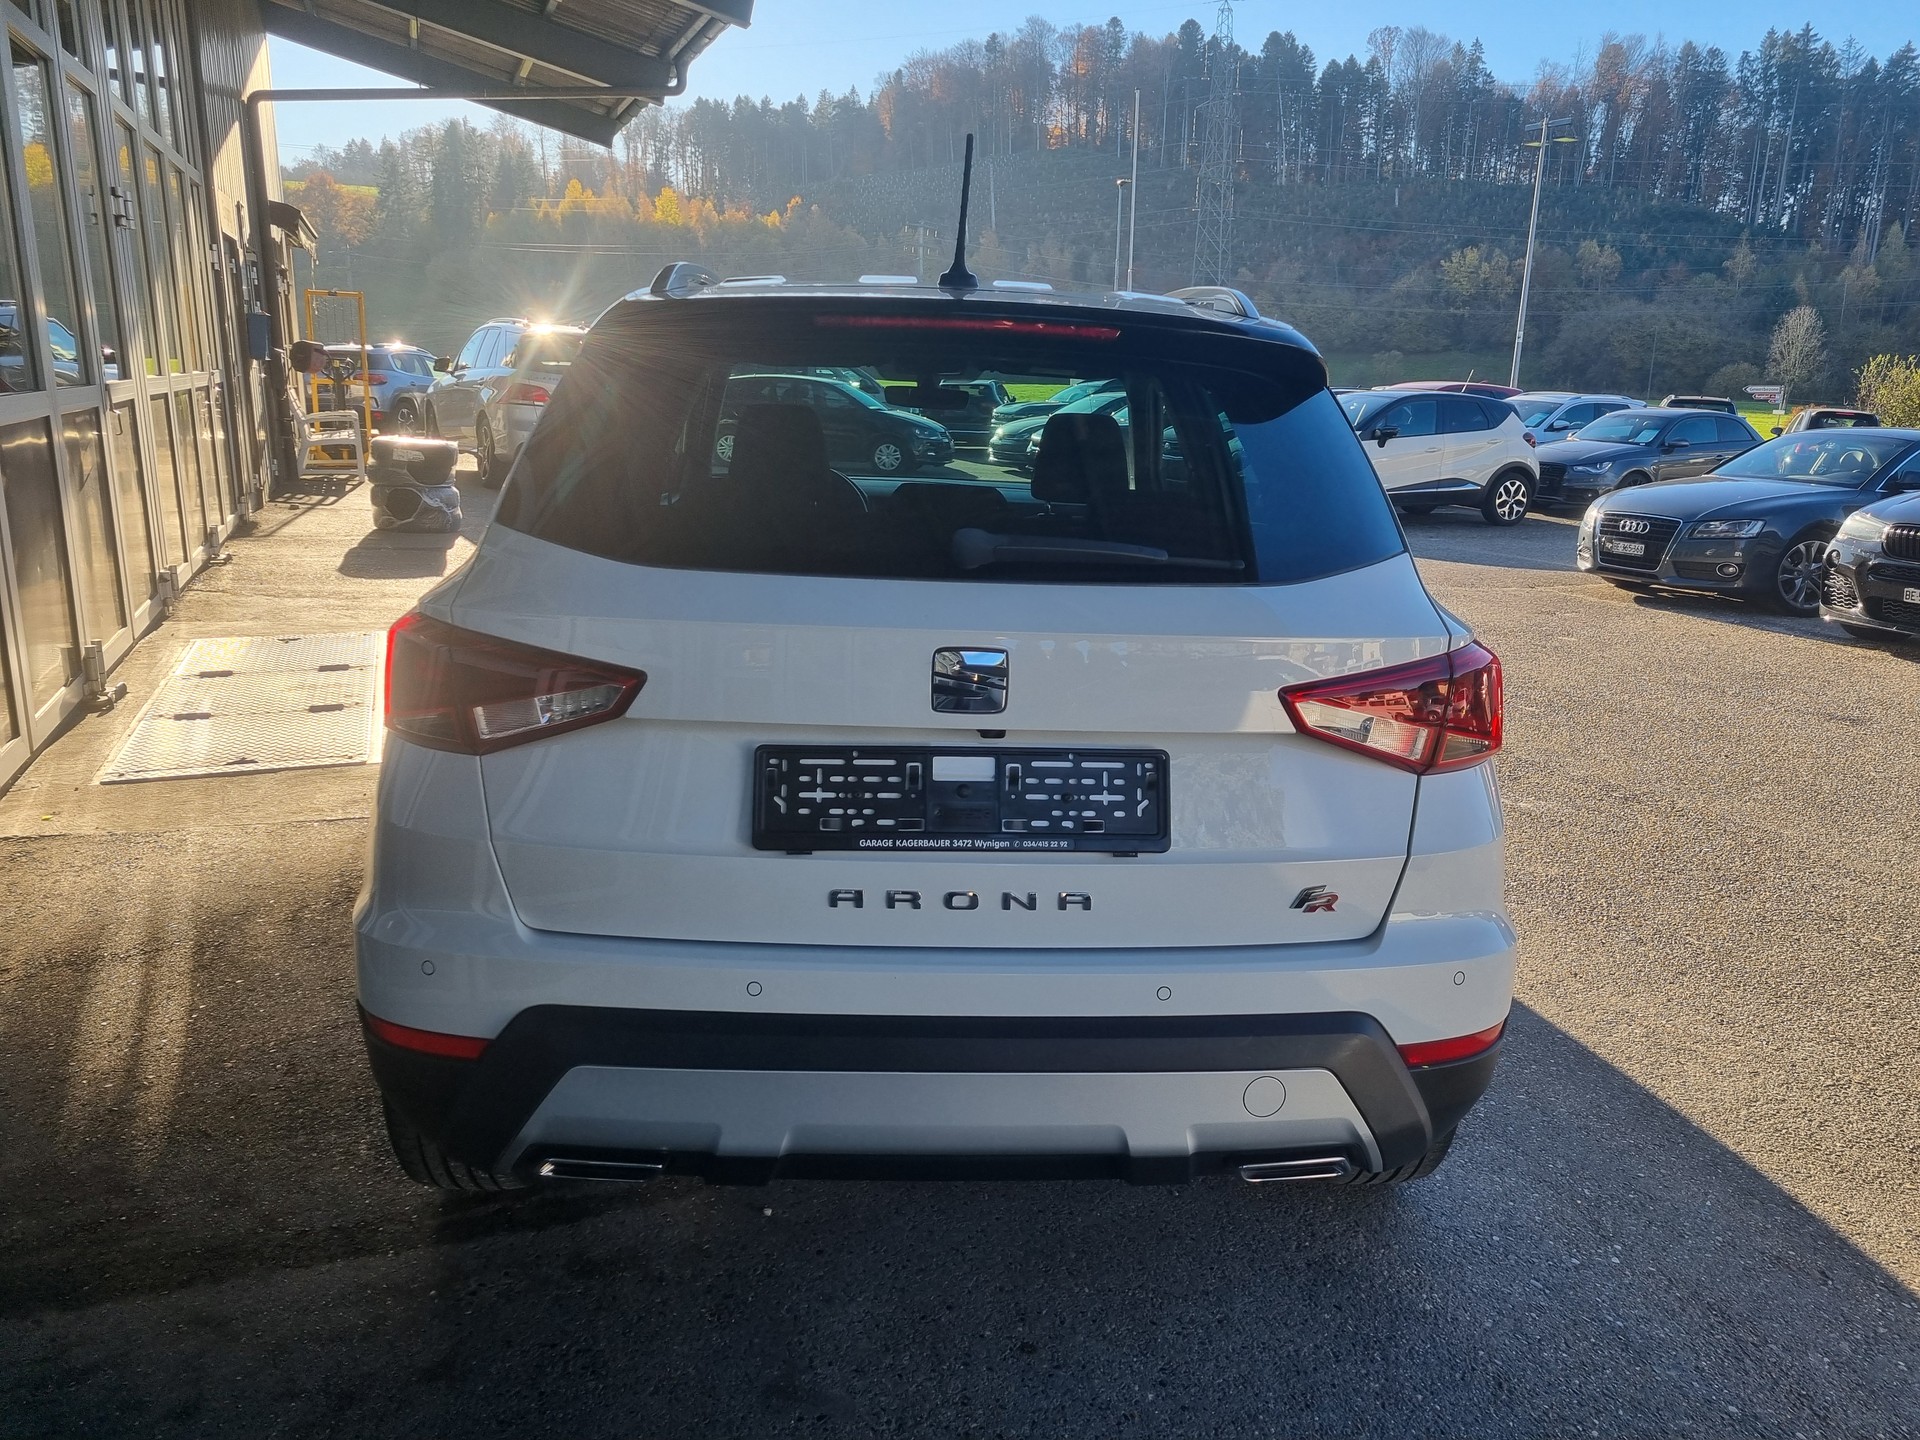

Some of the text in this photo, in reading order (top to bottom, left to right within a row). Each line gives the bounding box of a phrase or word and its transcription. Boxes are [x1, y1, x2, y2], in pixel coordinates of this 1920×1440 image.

[859, 839, 1068, 849] GARAGE KAGERBAUER 3472 Wynigen 034/415 22 92
[828, 888, 1092, 911] ARONA
[1289, 884, 1339, 913] FR
